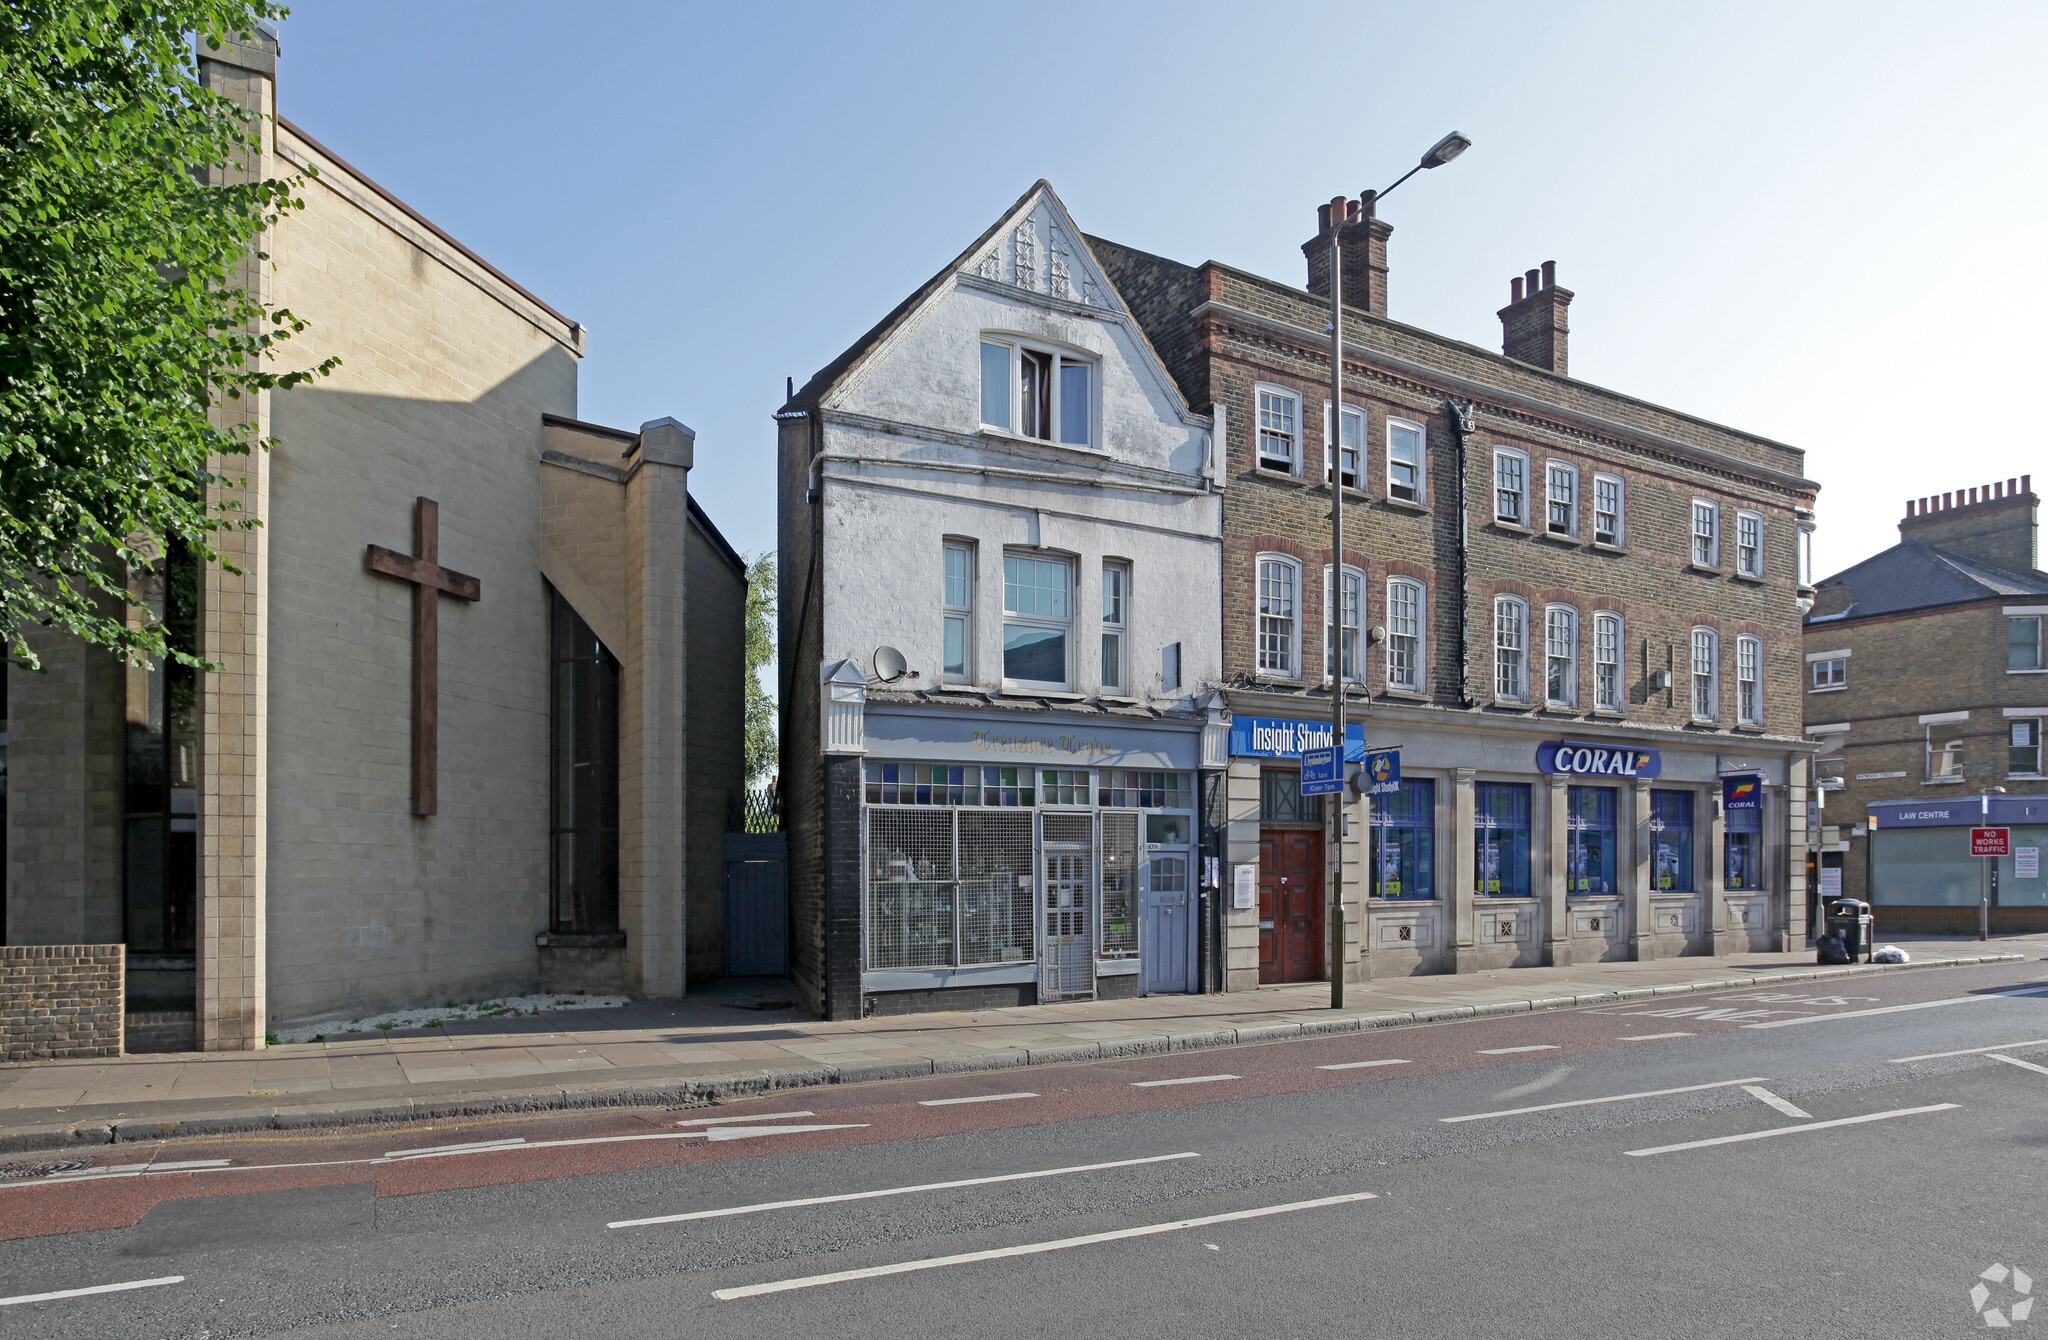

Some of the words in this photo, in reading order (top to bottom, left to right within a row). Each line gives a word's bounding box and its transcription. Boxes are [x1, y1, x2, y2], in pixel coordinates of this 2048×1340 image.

[972, 729, 1054, 754] Treasure
[1059, 733, 1112, 756] Trove
[1253, 720, 1295, 755] Insight
[1297, 723, 1333, 753] Study
[1554, 747, 1637, 776] CORAL
[1381, 780, 1400, 793] StudyUK
[1728, 801, 1756, 809] CORAL
[1899, 812, 1917, 820] LAW
[1918, 811, 1950, 819] CENTRE
